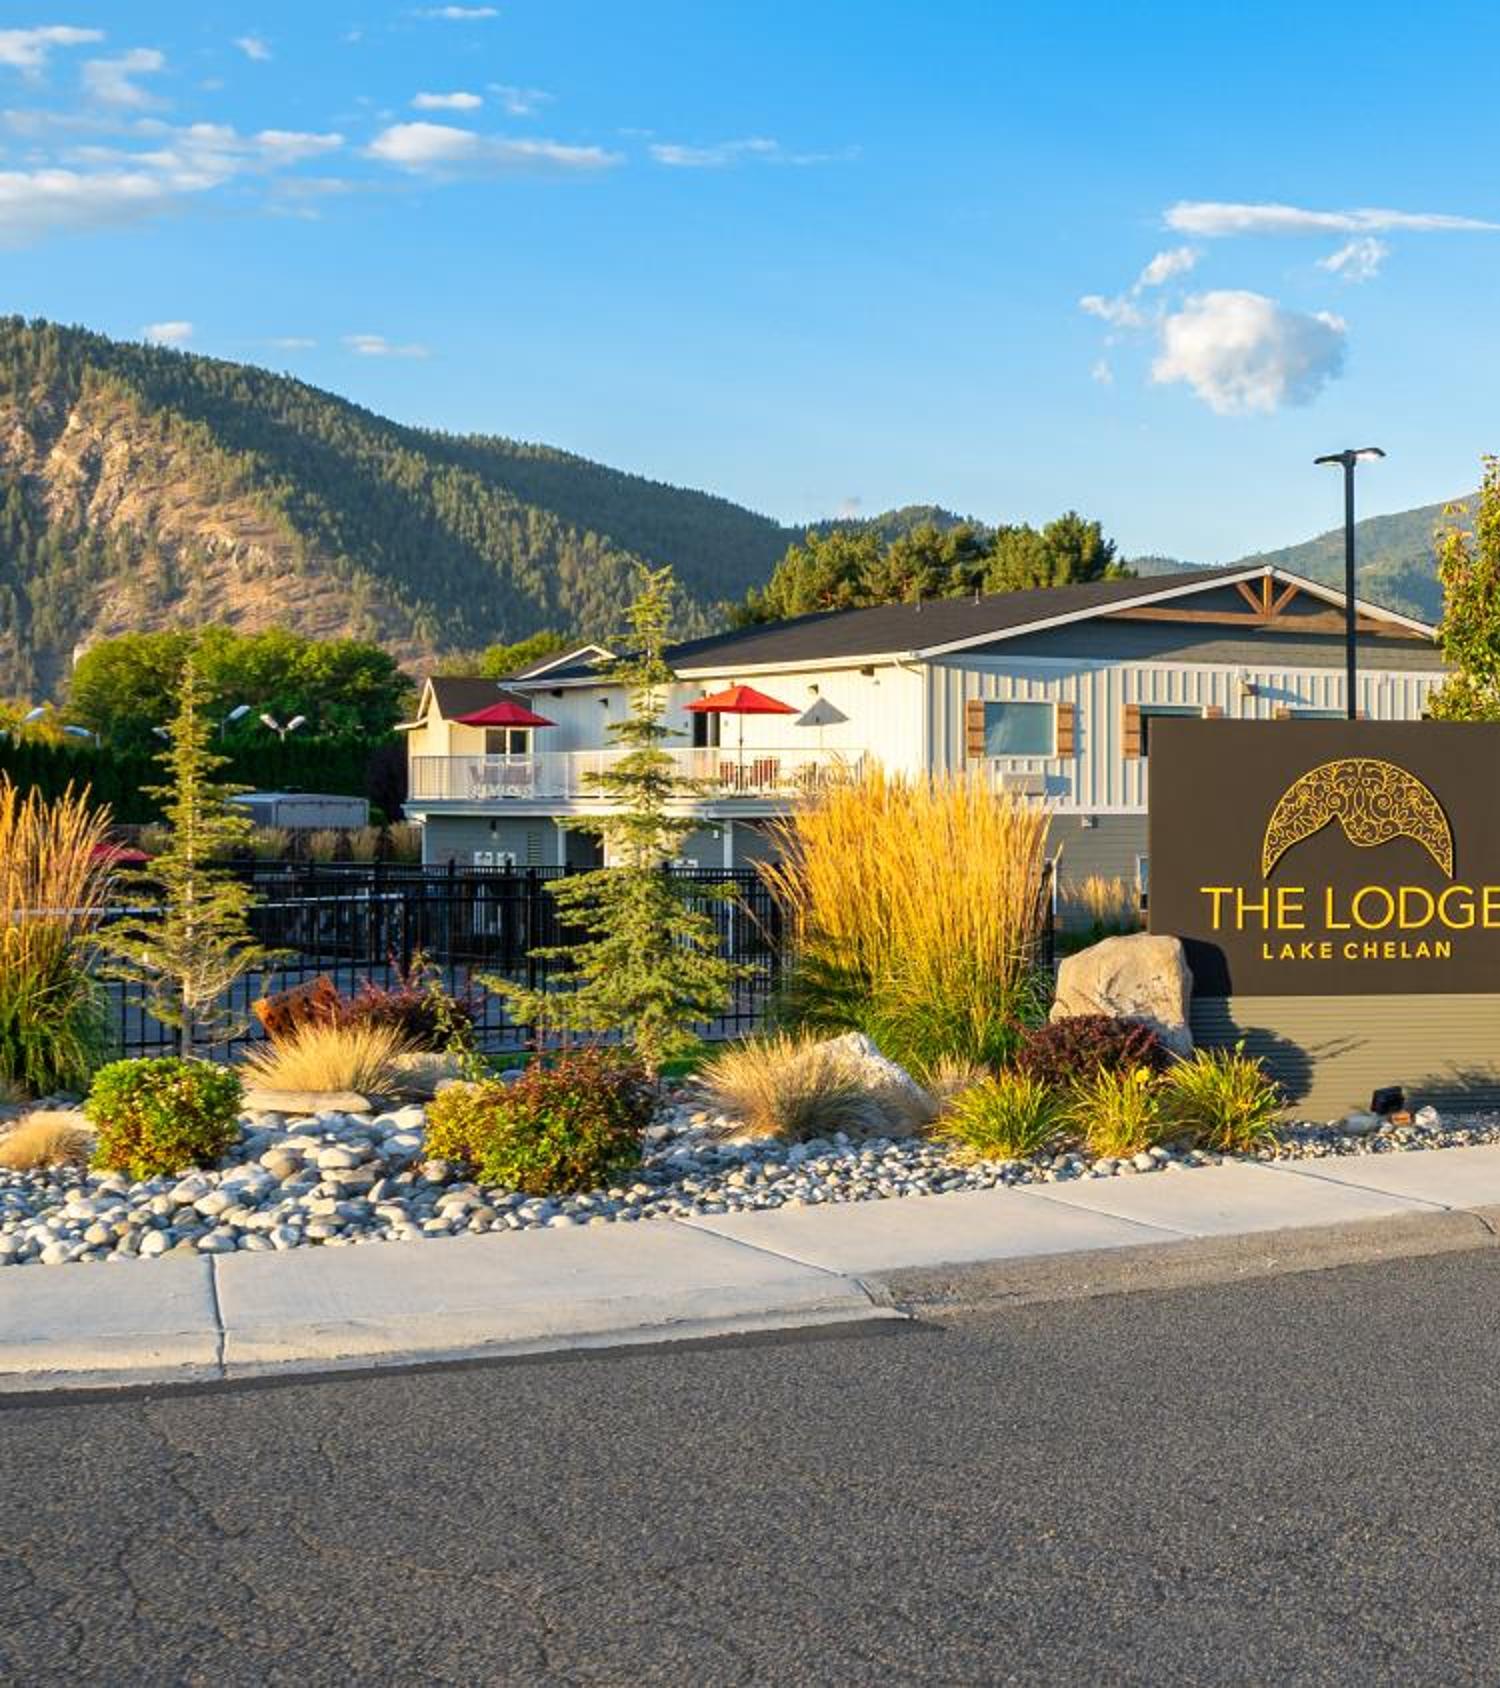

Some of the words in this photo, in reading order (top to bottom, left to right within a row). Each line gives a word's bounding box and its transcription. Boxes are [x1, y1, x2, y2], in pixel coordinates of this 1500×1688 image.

[1200, 887, 1305, 929] THE
[1263, 943, 1333, 960] LAKE
[1344, 941, 1452, 959] CHELAN
